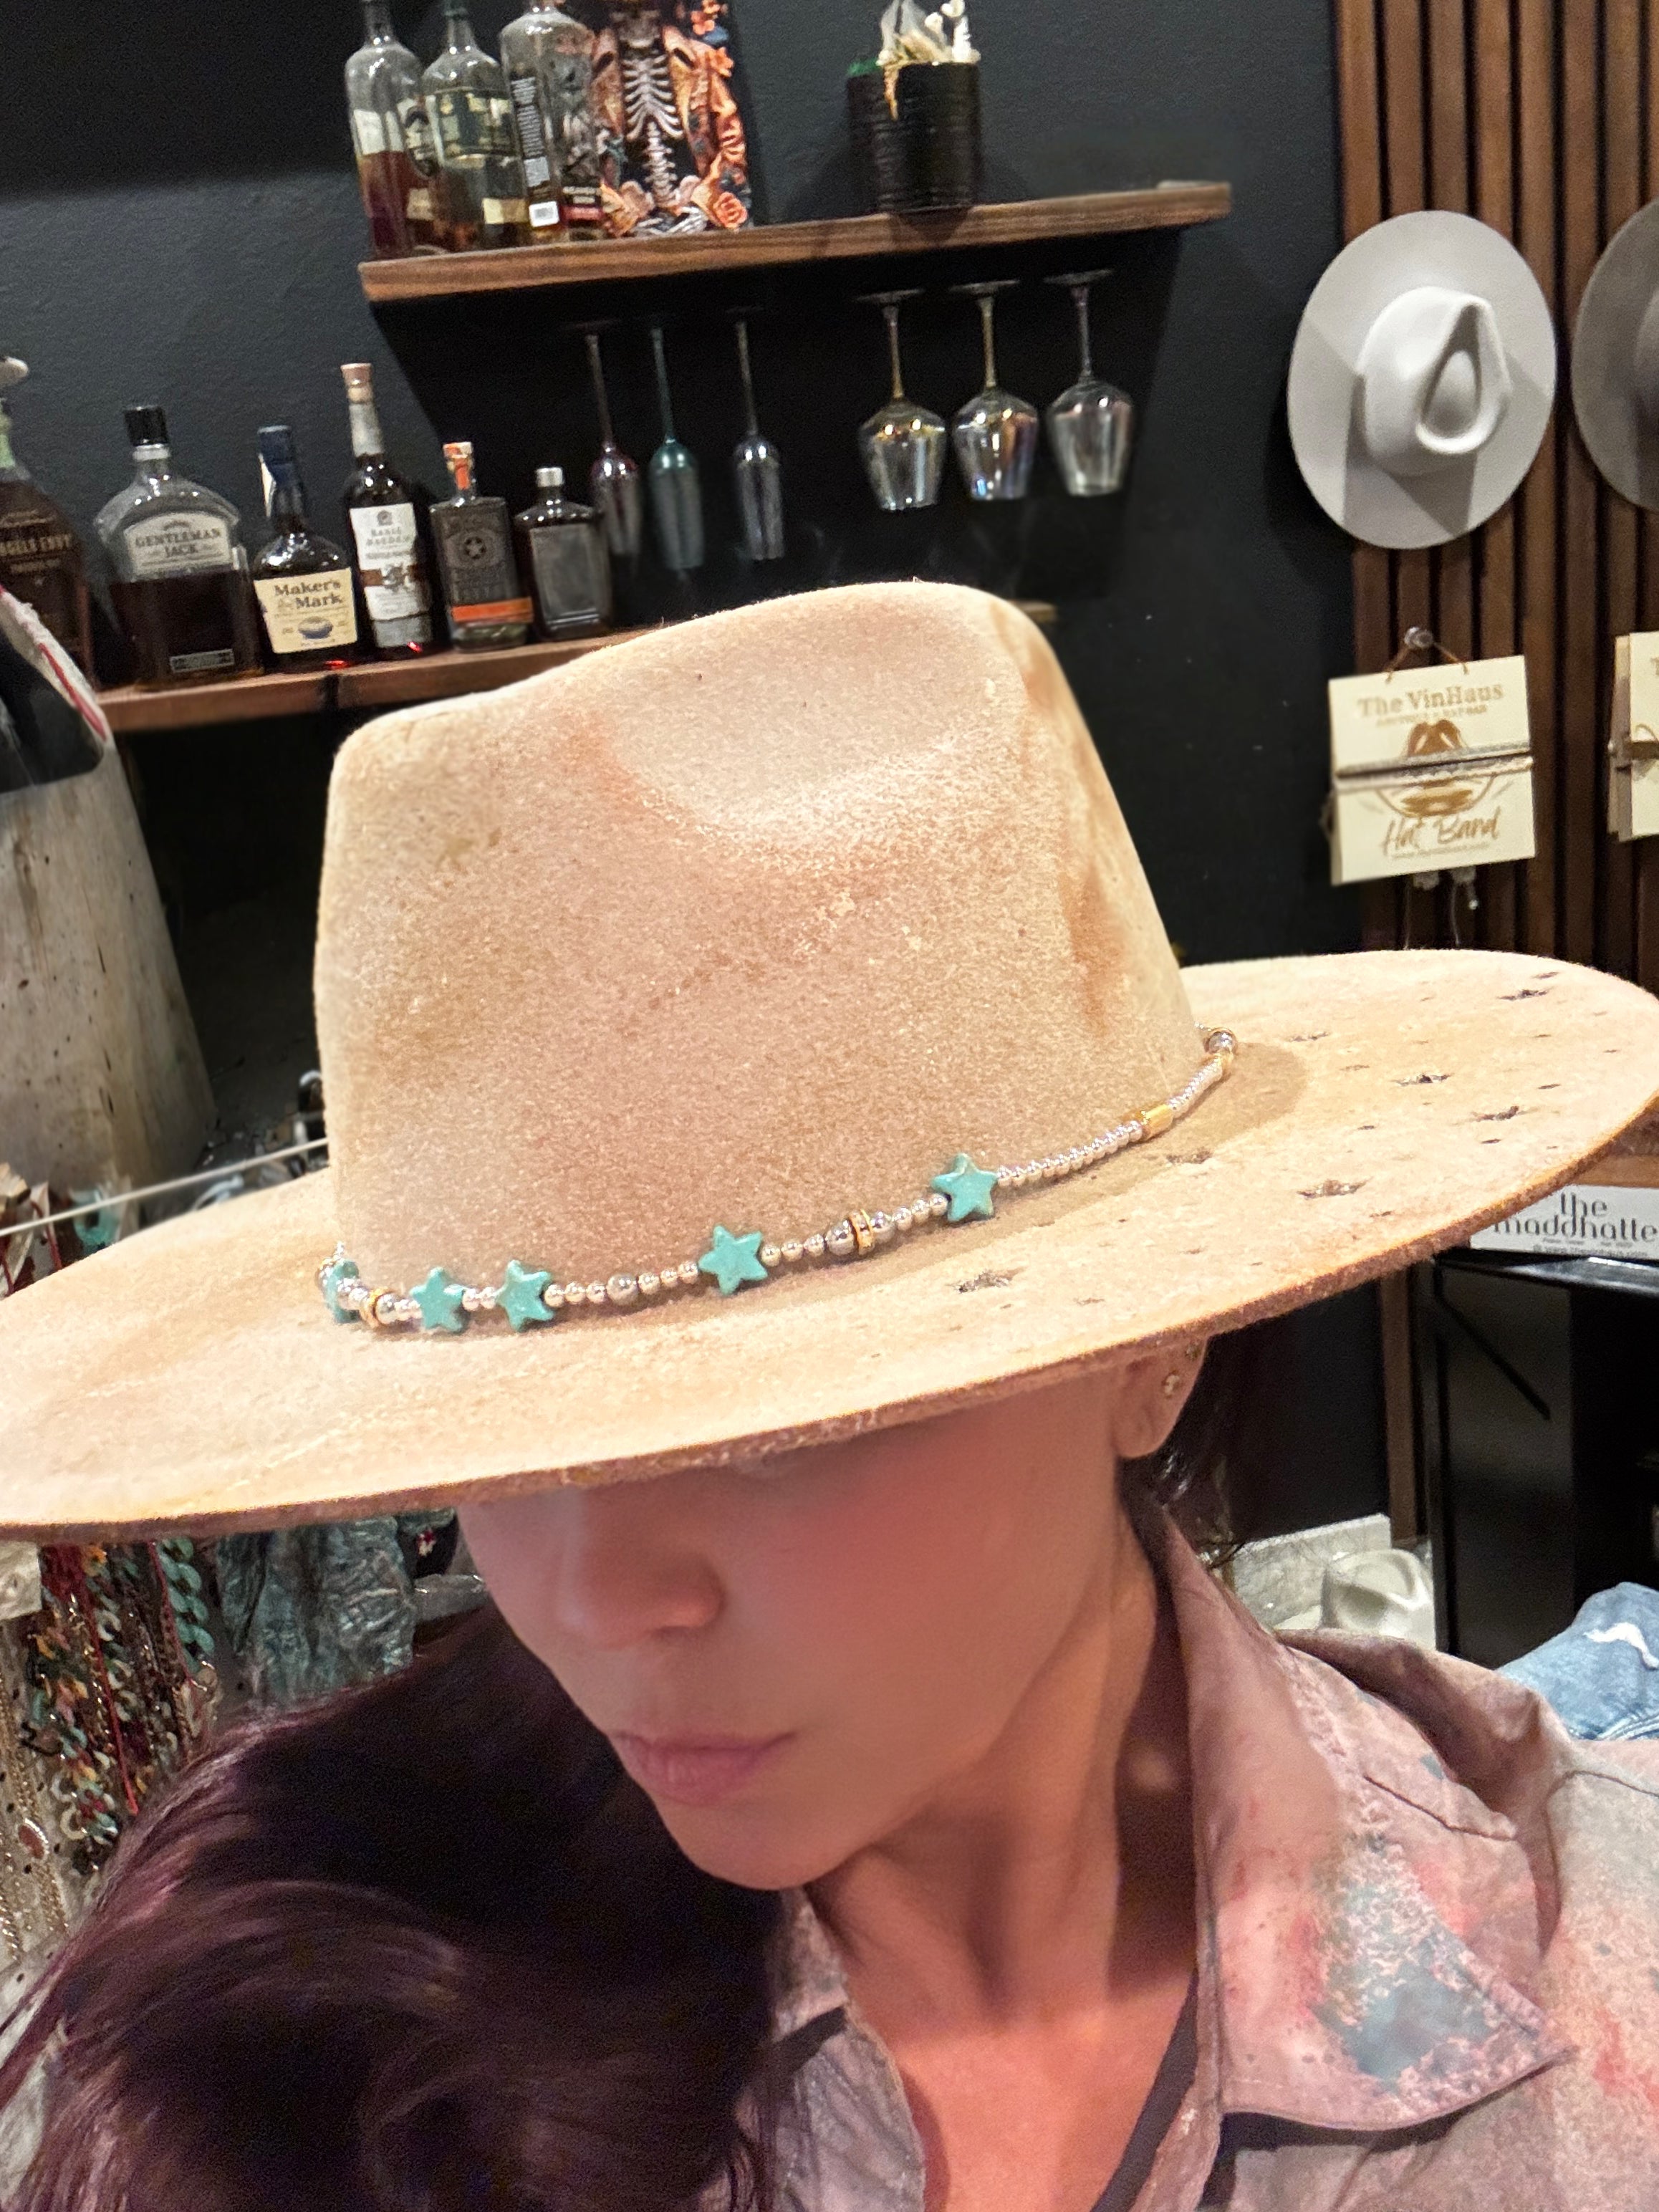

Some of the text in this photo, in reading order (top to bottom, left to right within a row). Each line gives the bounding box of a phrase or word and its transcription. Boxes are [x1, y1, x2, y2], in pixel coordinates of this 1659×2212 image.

[135, 528, 221, 547] GENTLEMAN
[165, 544, 198, 558] JACK
[274, 579, 341, 596] Maker's
[295, 592, 343, 610] Mark
[1357, 696, 1403, 717] The
[1405, 683, 1504, 710] VinHaus
[1380, 817, 1424, 857] Hat
[1433, 805, 1501, 845] Band
[1559, 1191, 1607, 1218] the
[1494, 1213, 1659, 1244] maddhatte
